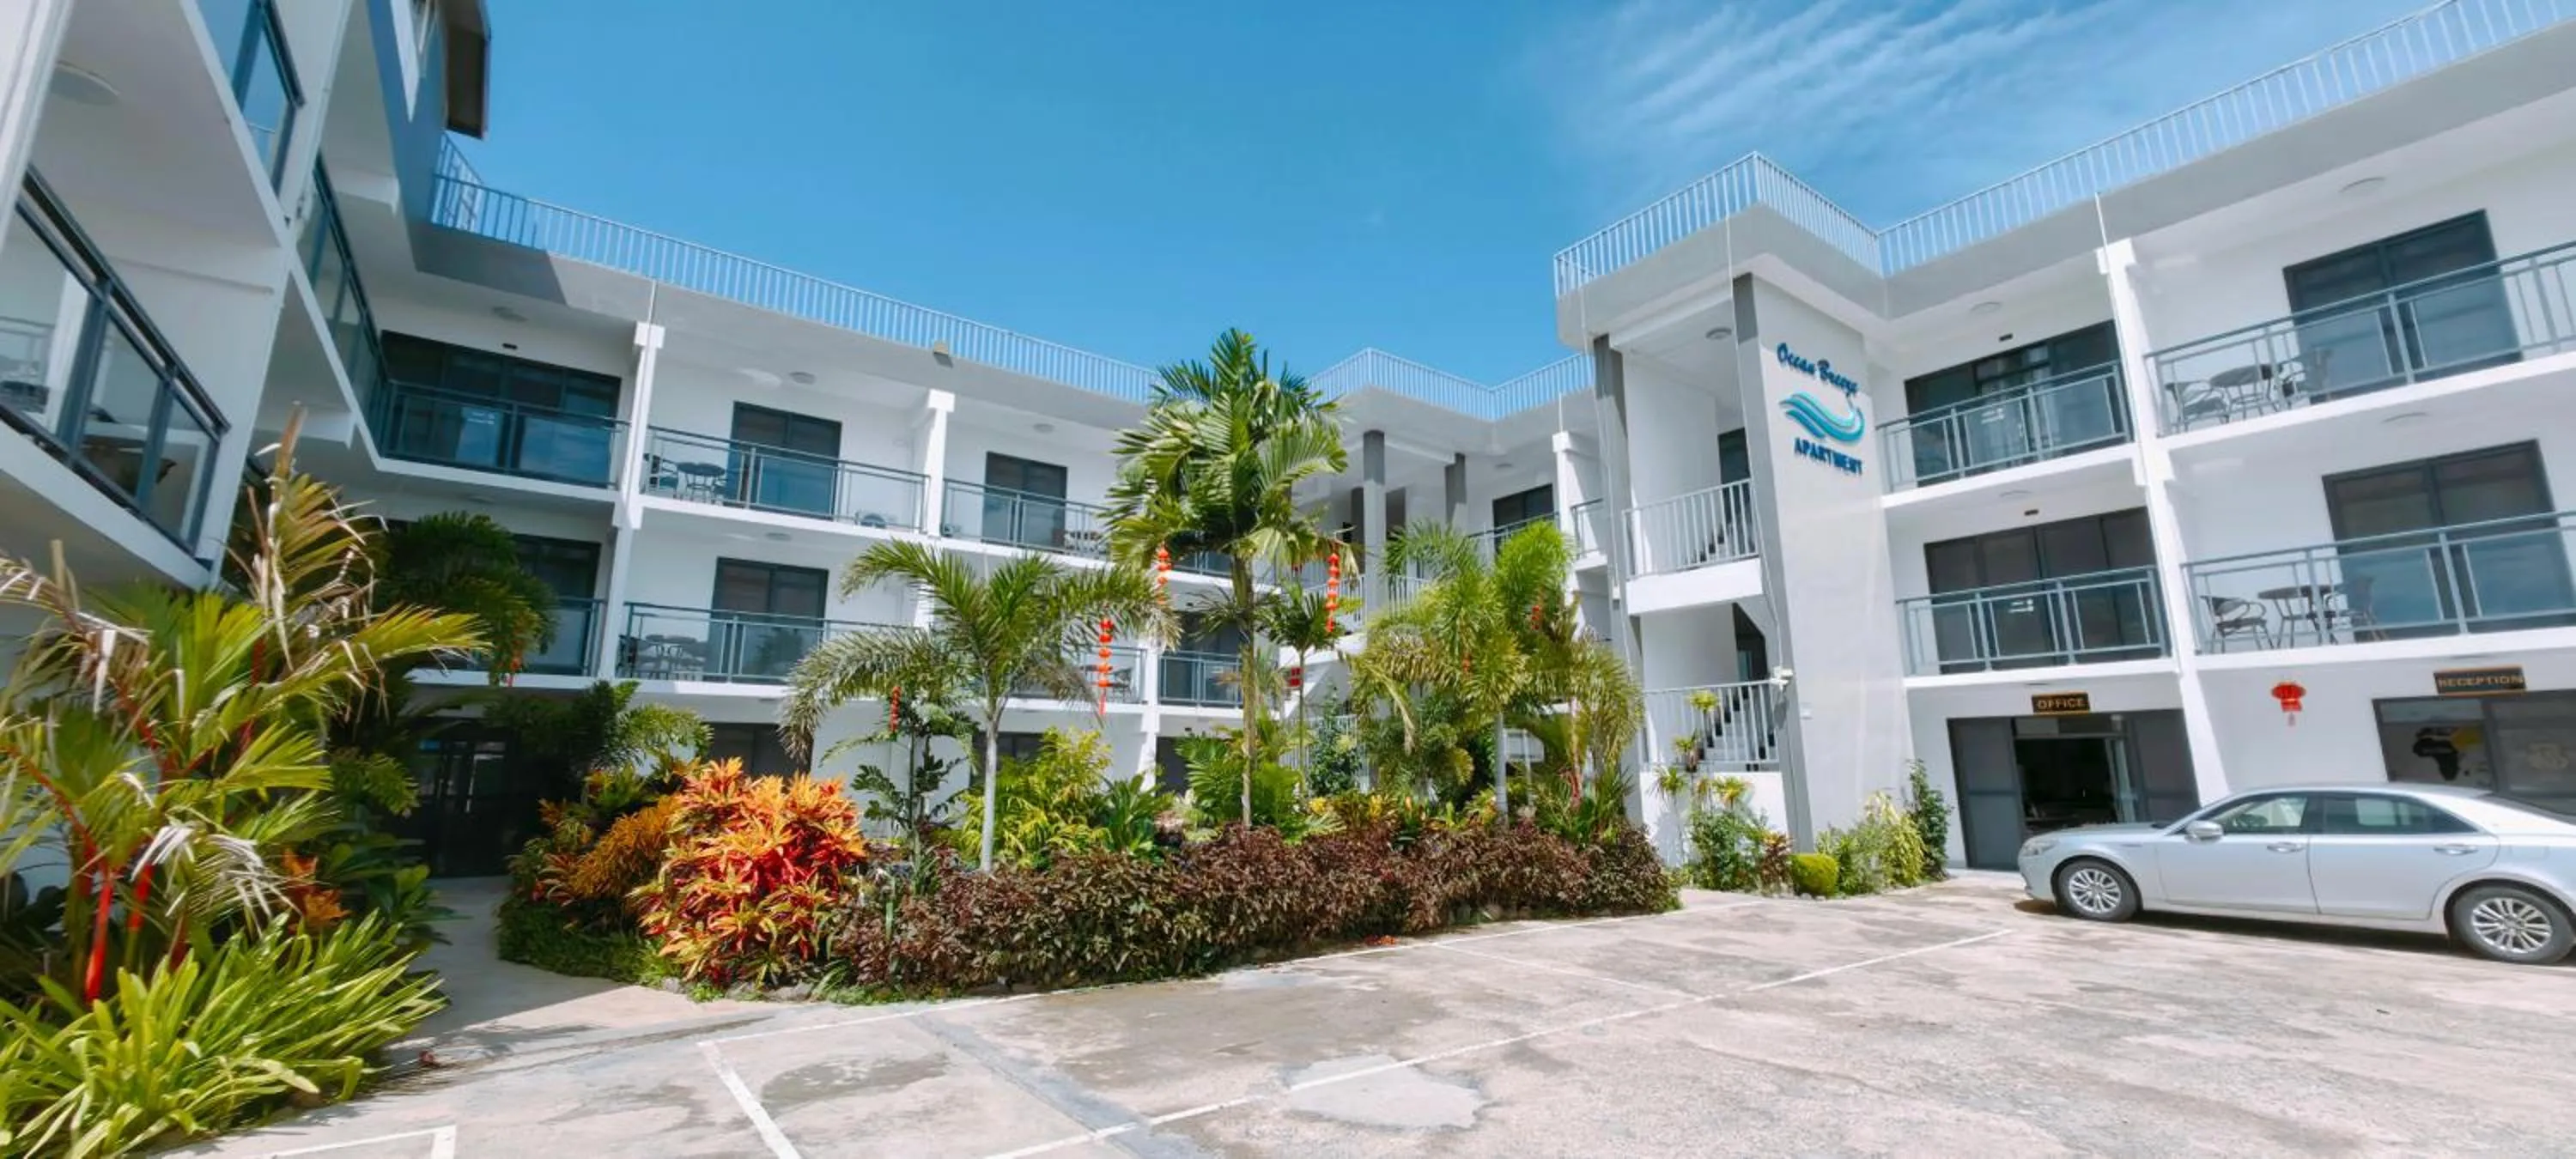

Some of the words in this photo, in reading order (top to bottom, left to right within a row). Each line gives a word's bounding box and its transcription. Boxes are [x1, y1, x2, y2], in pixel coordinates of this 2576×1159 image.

[1777, 343, 1815, 375] Ocean
[1817, 359, 1858, 398] Breeze
[1794, 438, 1862, 476] APARTMENT
[2438, 676, 2524, 688] RECEPTION
[2037, 698, 2087, 710] OFFICE
